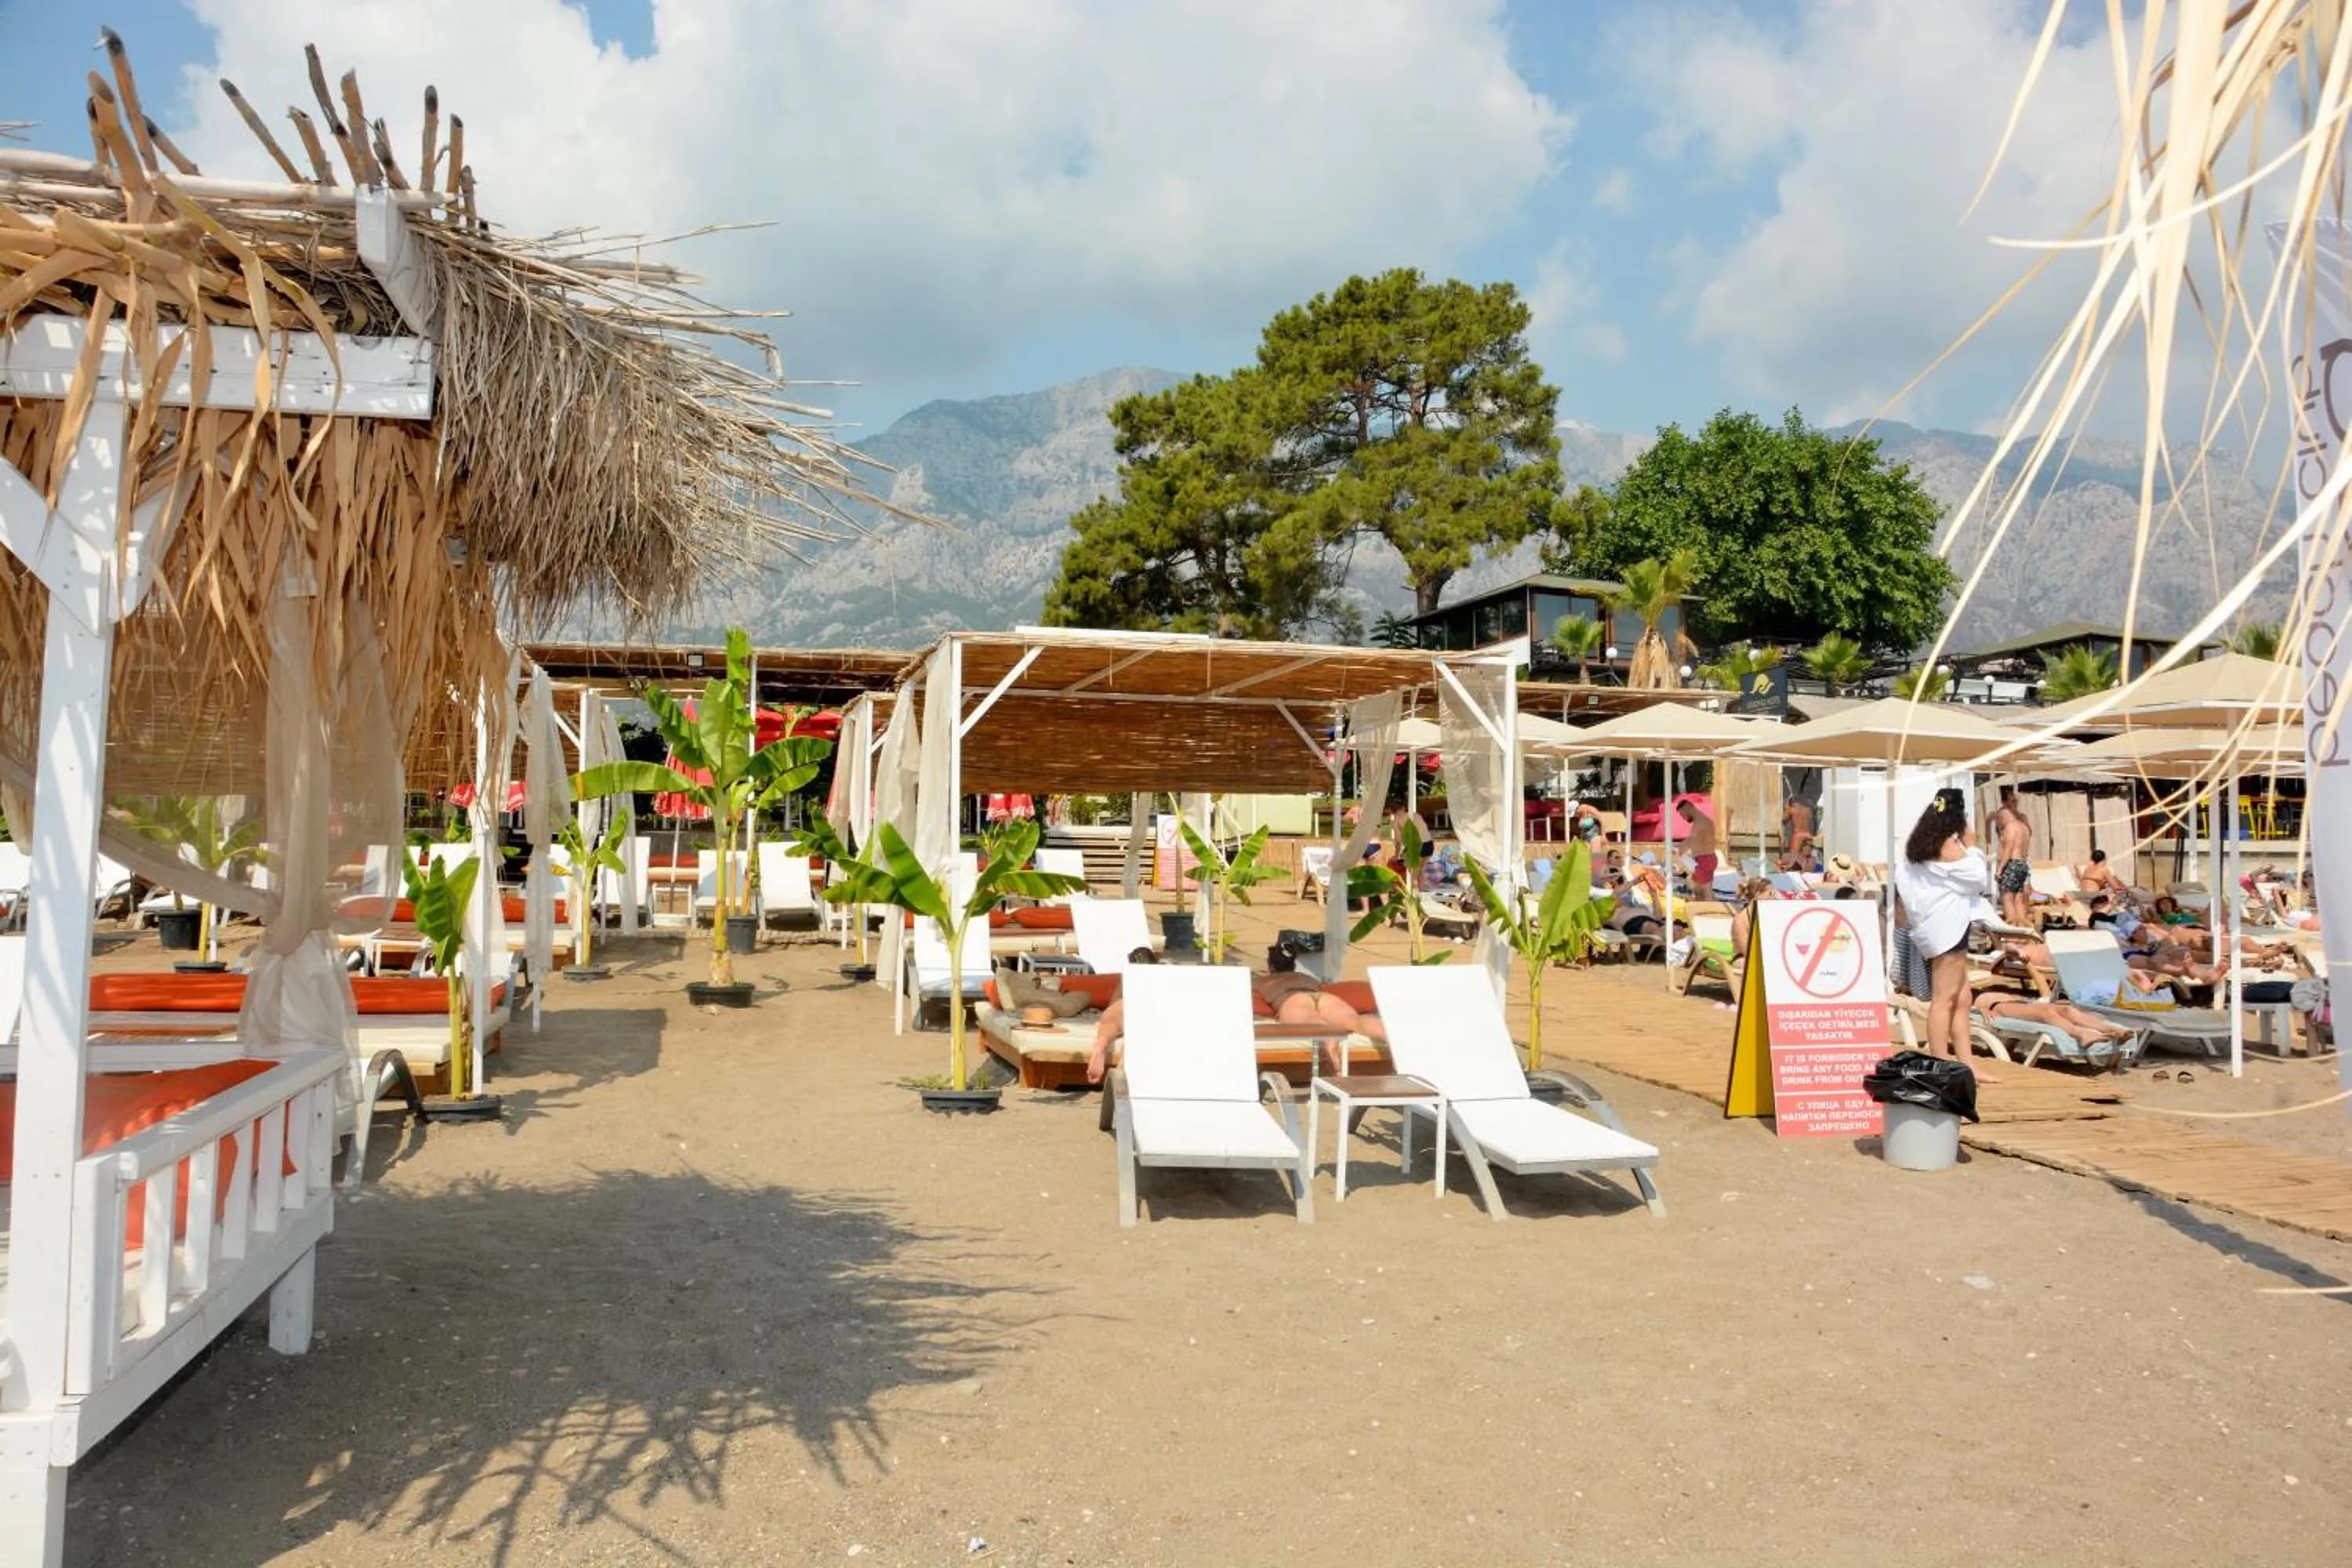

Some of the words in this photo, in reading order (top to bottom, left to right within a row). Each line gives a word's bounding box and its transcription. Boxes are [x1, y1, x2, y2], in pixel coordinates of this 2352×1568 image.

[1784, 1054, 1795, 1064] IT
[1796, 1054, 1806, 1063] IS
[1808, 1053, 1864, 1062] FORBIDDEN
[1780, 1065, 1810, 1074] BRING
[1813, 1065, 1832, 1073] ANY
[1834, 1063, 1862, 1073] FOOD
[1781, 1076, 1812, 1086] DRINK
[1815, 1075, 1842, 1084] FROM
